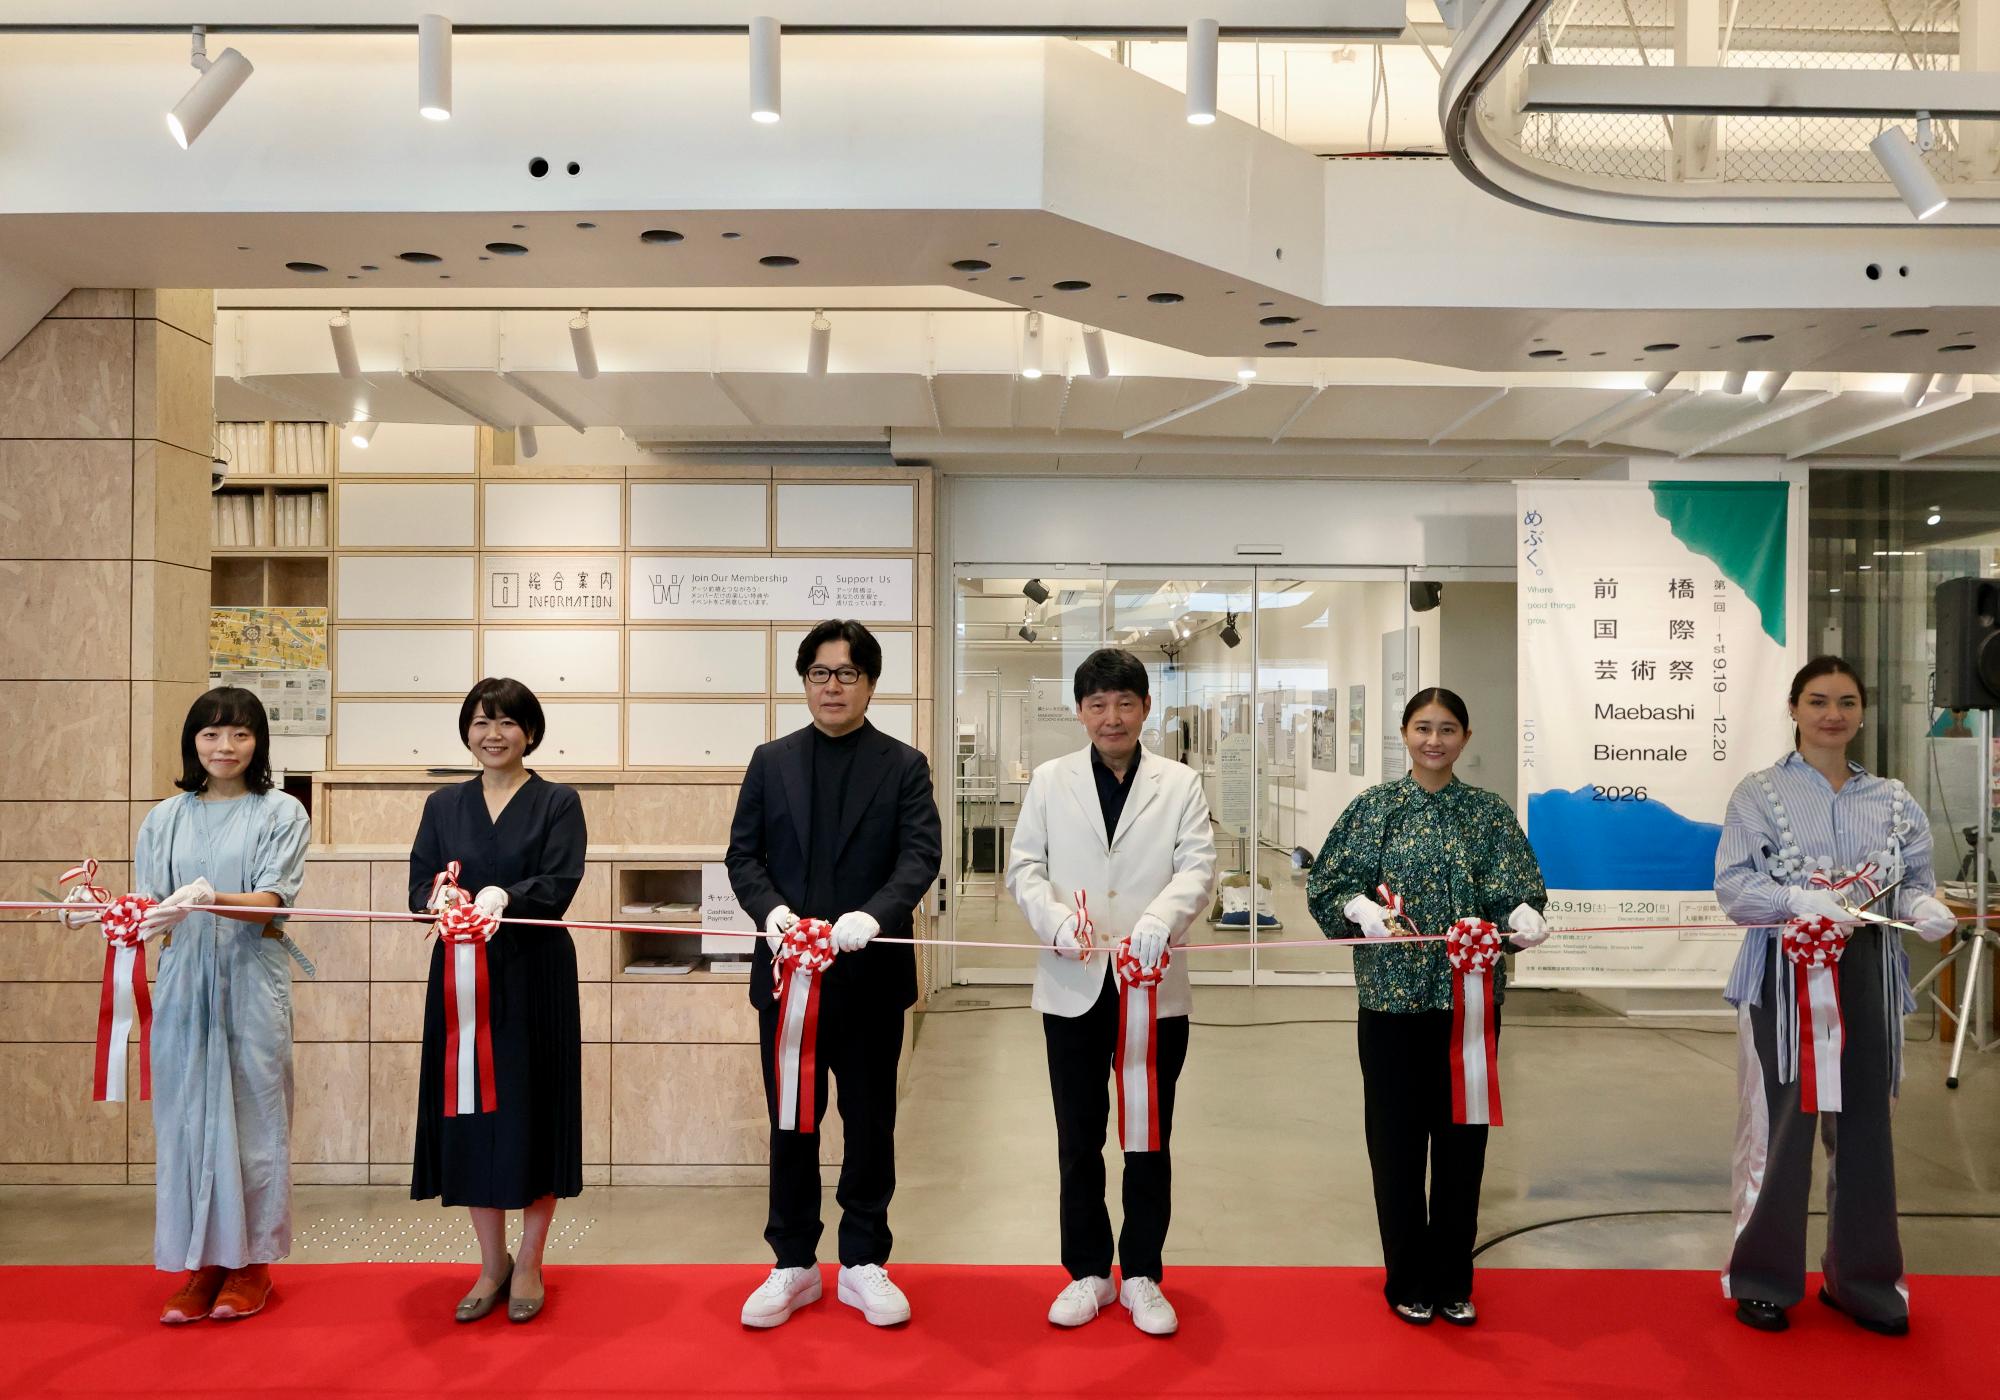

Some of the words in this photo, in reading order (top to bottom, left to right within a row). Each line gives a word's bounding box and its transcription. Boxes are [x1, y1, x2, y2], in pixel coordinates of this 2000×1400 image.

[1523, 510, 1544, 576] めぶく。
[528, 572, 612, 591] 総合案内
[692, 573, 709, 584] Join
[711, 573, 729, 583] Our
[731, 574, 788, 584] Membership
[836, 575, 873, 584] Support
[879, 575, 892, 584] Us
[1527, 585, 1554, 594] Where
[1593, 577, 1695, 600] 前橋
[1712, 579, 1727, 613] 第一回
[528, 595, 613, 609] INFORMATION
[1527, 601, 1548, 610] good
[1550, 601, 1576, 611] things
[1593, 618, 1695, 640] 国際
[1593, 659, 1695, 681] 芸術祭
[1594, 703, 1695, 721] Maebashi
[1593, 744, 1688, 762] Biennale
[1592, 785, 1648, 803] 2026
